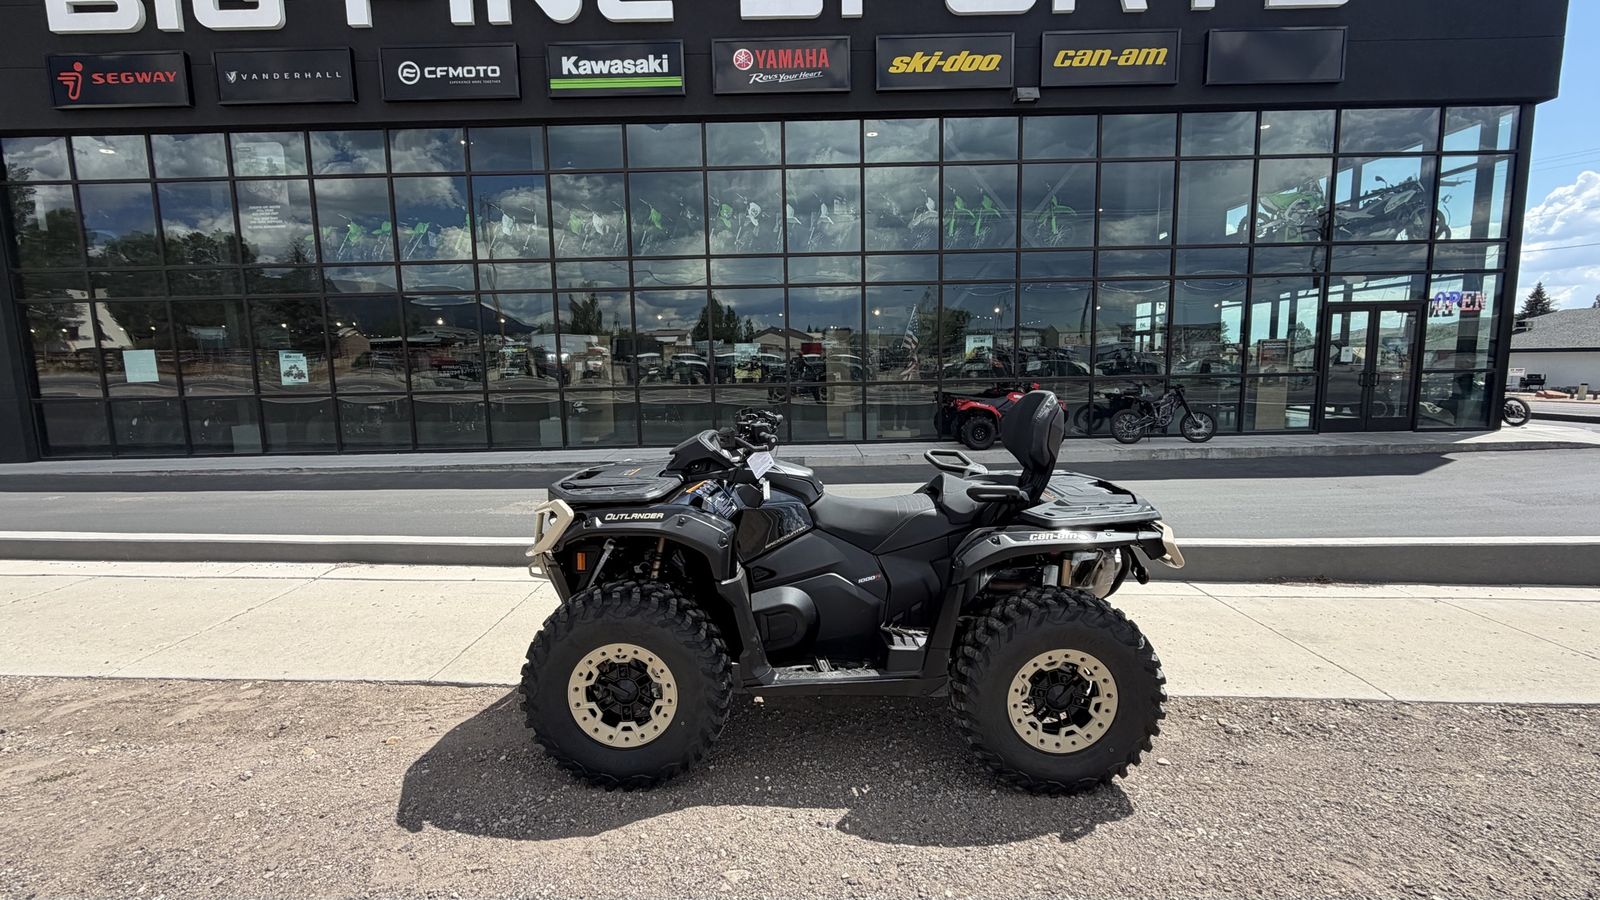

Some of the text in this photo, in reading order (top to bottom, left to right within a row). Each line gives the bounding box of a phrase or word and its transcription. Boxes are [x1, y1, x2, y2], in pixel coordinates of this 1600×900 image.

[561, 54, 669, 75] Kawasaki
[755, 47, 829, 69] YAMAHA
[91, 71, 177, 85] SEGWAY
[240, 71, 342, 81] VANDERHALL
[424, 65, 501, 78] CFMOTO
[749, 70, 823, 84] Revs Your Heart
[1434, 290, 1486, 312] OPEN
